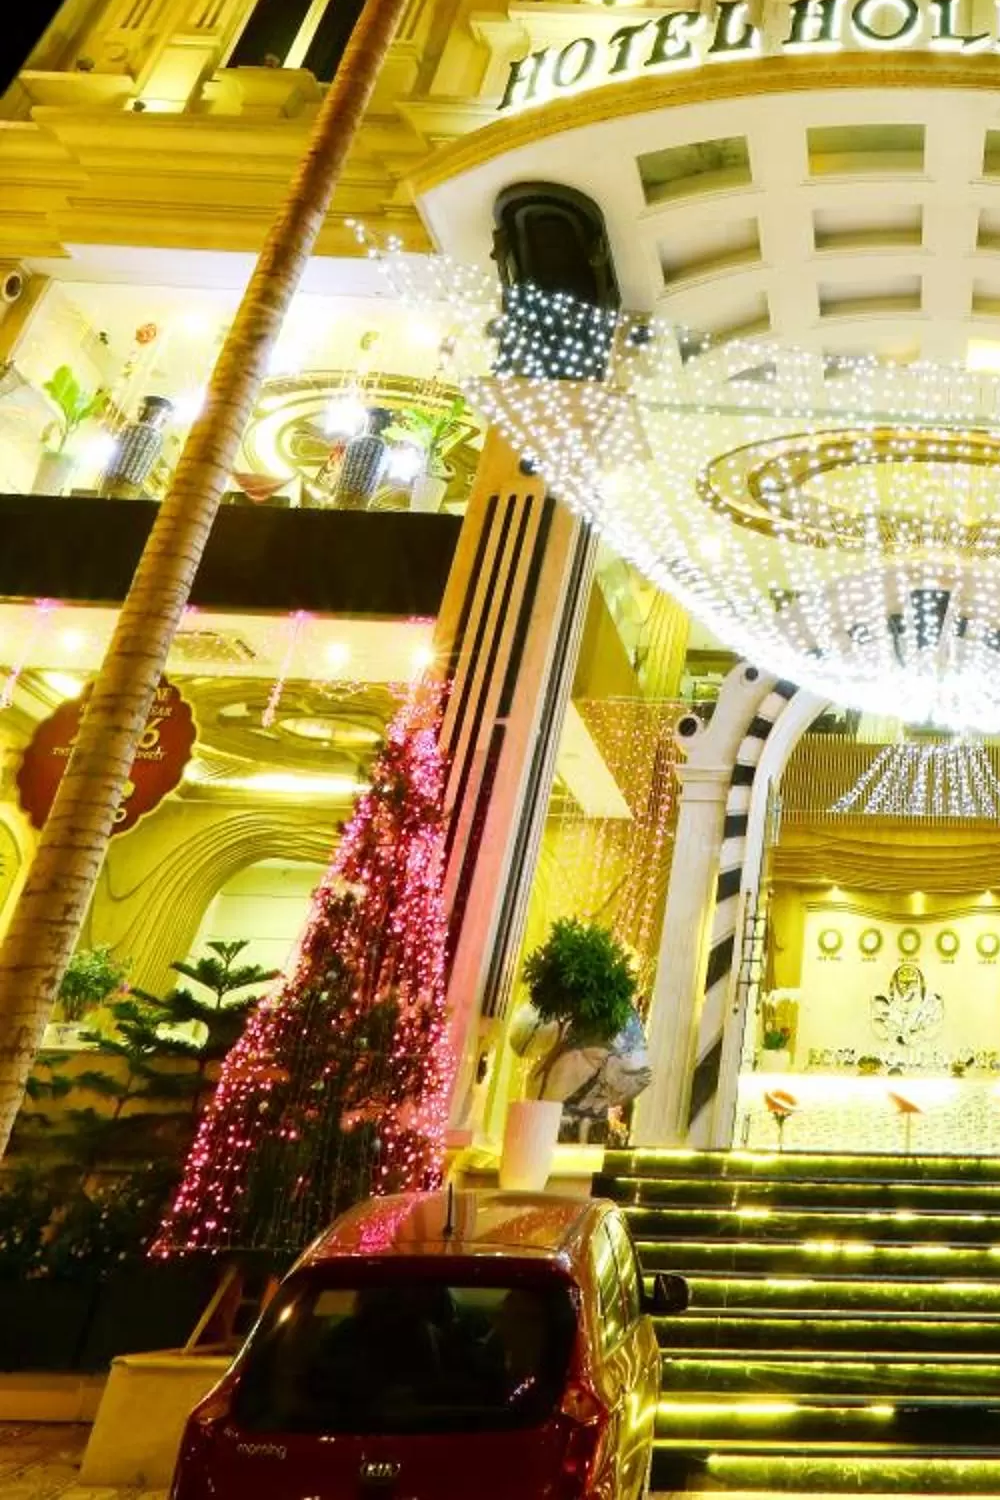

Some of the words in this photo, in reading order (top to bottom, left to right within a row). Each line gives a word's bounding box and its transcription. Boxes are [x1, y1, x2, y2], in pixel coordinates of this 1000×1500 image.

[496, 0, 757, 111] HOTEL
[236, 1443, 288, 1460] morning
[364, 1461, 395, 1478] KIA
